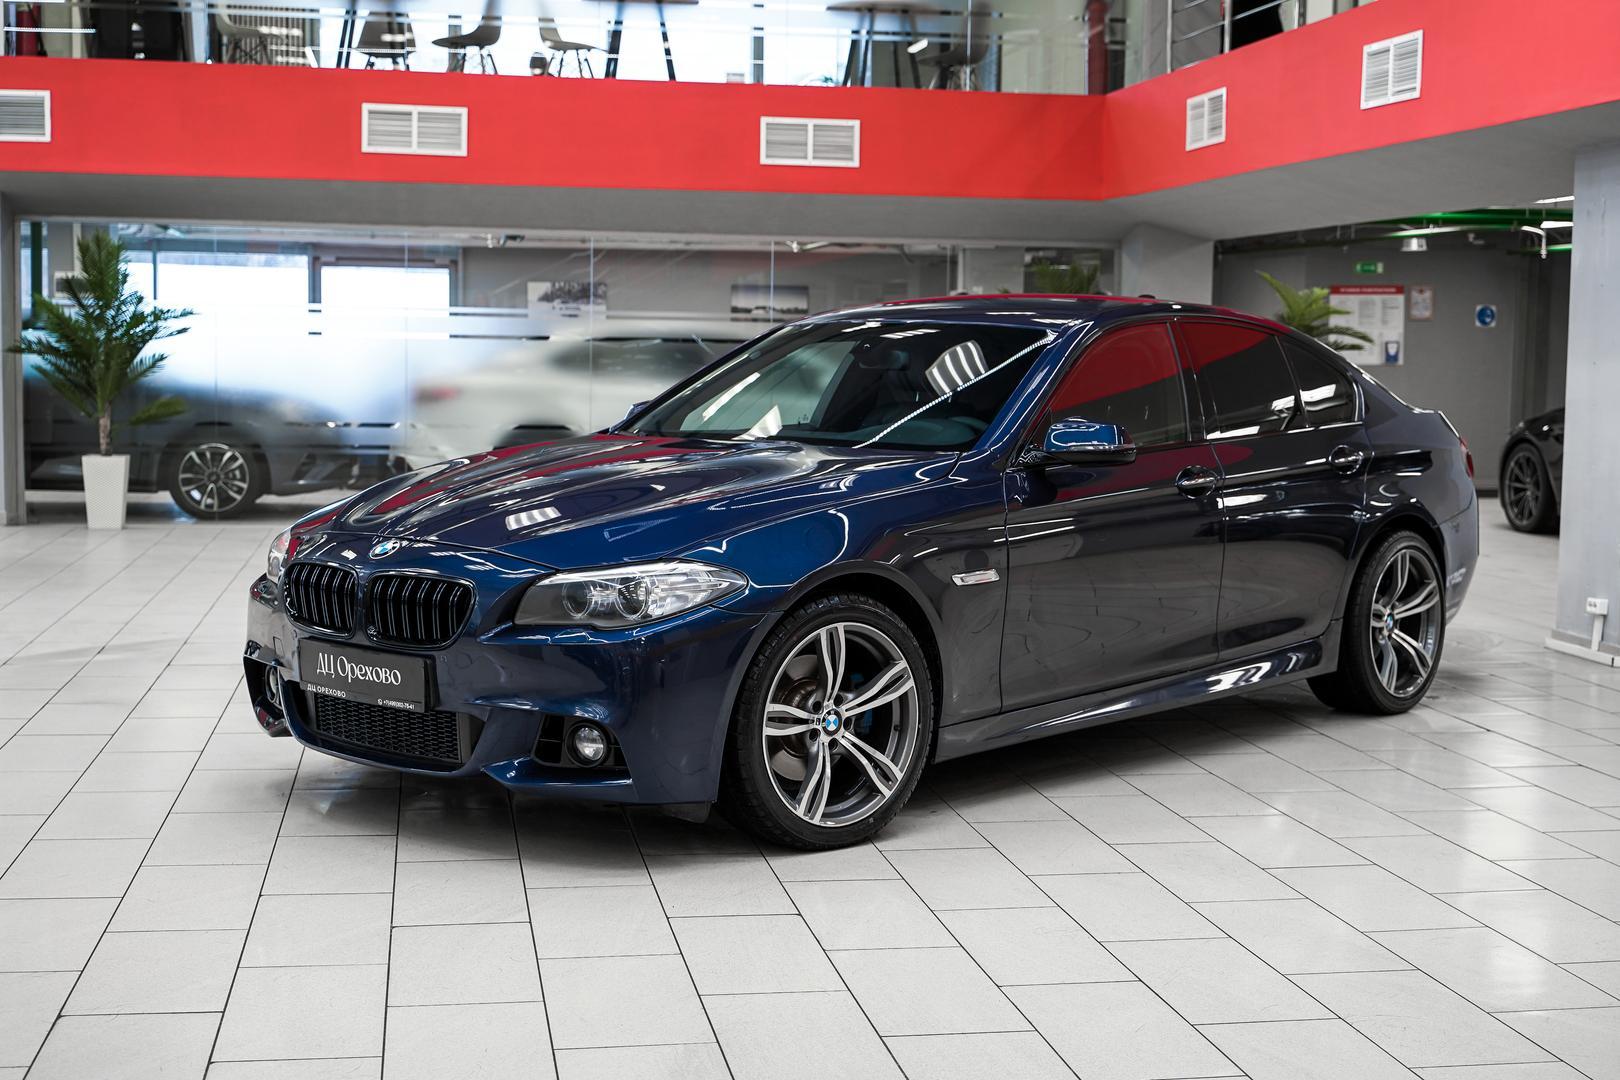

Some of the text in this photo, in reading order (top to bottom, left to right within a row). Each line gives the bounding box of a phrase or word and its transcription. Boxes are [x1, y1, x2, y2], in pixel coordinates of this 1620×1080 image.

[316, 652, 402, 686] ДЦ Орехово
[307, 683, 346, 698] ДЦ ОРЕХОВО
